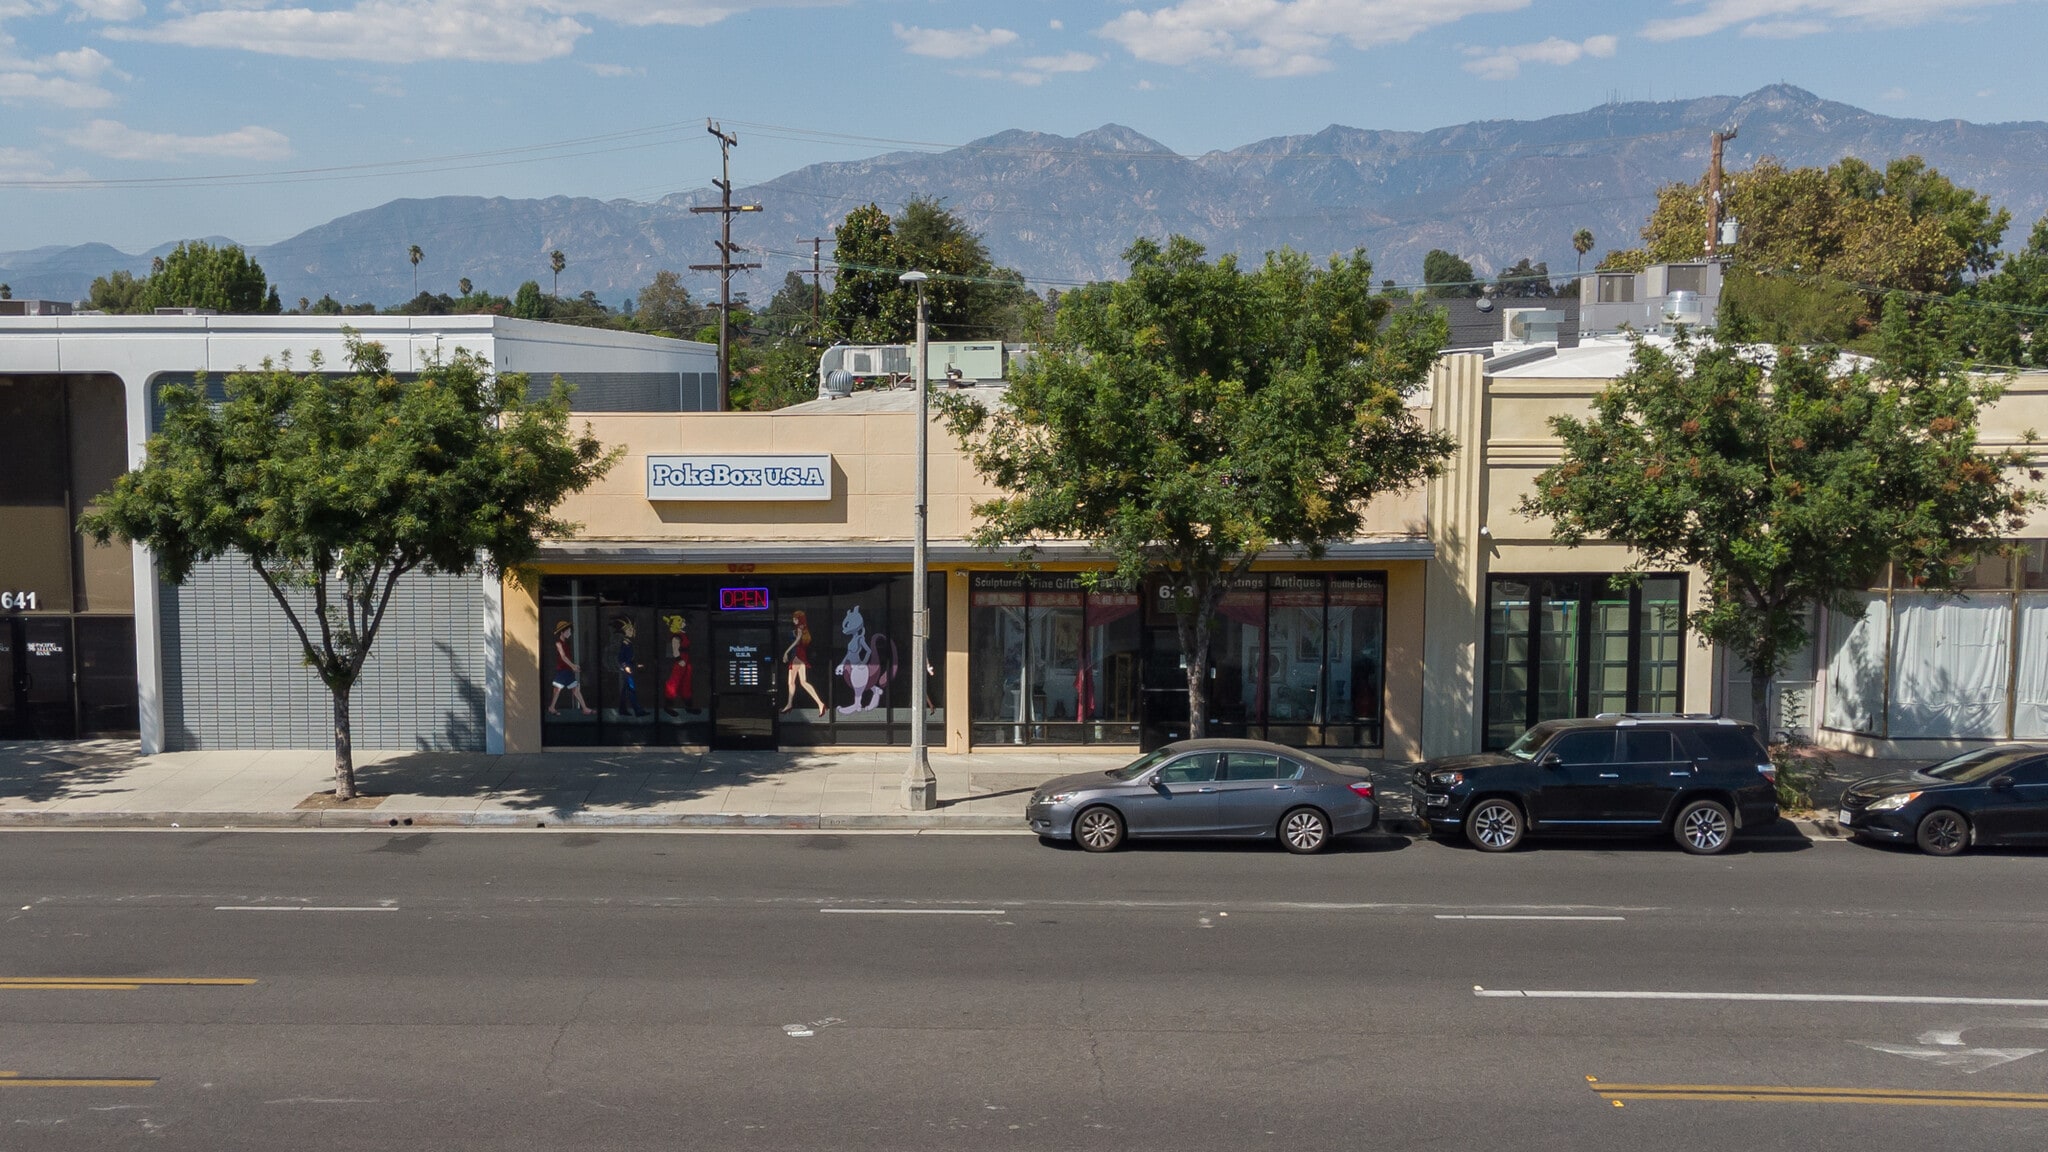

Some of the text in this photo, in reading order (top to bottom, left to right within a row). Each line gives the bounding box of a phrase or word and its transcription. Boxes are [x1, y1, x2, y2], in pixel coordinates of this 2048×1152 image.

[653, 463, 824, 486] PokeBox U.S.A
[975, 577, 1022, 589] Sculptures
[1032, 578, 1079, 589] Fine Gifts
[1274, 576, 1321, 590] Antiques
[1, 591, 36, 609] 641
[723, 591, 766, 608] OPEN
